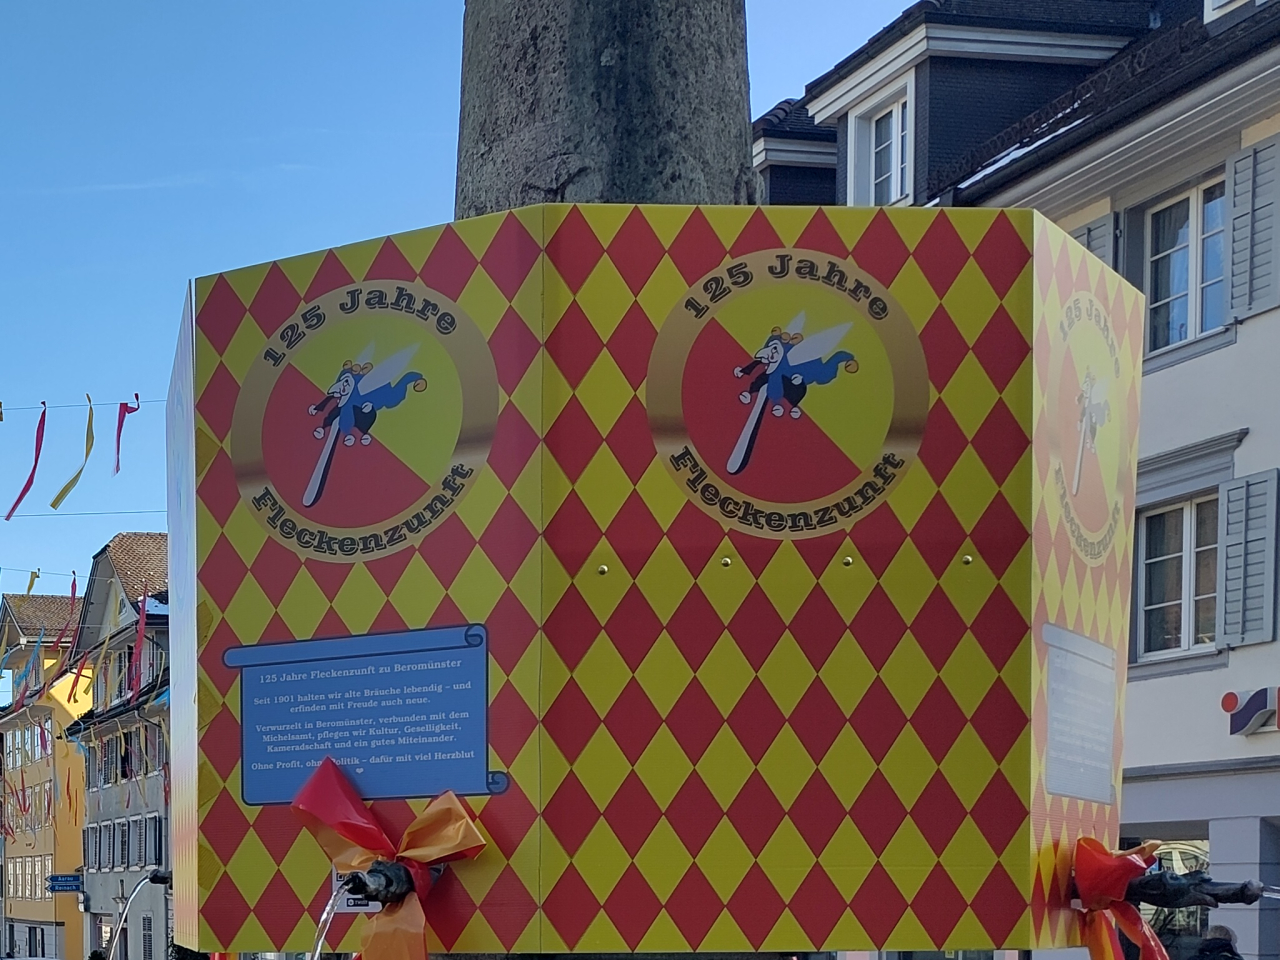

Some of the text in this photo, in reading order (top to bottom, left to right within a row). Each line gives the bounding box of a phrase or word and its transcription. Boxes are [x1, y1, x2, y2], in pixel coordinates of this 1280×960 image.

[684, 254, 889, 320] 125 Jahre
[263, 285, 458, 367] 125 Jahre
[1059, 298, 1082, 342] 125
[669, 446, 905, 532] Fleckenzunft
[252, 463, 474, 556] Fleckenzunft
[260, 660, 462, 683] 125 Jahre Fleckenzunft zu Beromünster
[254, 697, 271, 705] Seit
[274, 695, 294, 704] 1901
[297, 693, 325, 702] halten
[328, 691, 342, 699] wir
[344, 690, 361, 698] alte
[364, 687, 401, 697] Bräuche
[403, 683, 443, 694] lebendig
[453, 681, 471, 690] und
[290, 697, 431, 713] erfinden mit Freude auch neue.
[255, 710, 469, 732] Verwurzelt in Beromünster, verbunden mit dem
[262, 733, 315, 743] Michelsamt,
[317, 731, 350, 741] pflegen
[369, 727, 401, 736] Kultur,
[404, 722, 462, 734] Geselligkeit,
[267, 734, 457, 753] Kameradschaft und ein gutes Miteinander.
[251, 762, 274, 770] Ohne
[276, 760, 304, 769] Profit,
[306, 759, 323, 767] ohn
[369, 756, 393, 764] dafür
[396, 754, 412, 762] mit
[414, 752, 432, 761] viel
[434, 750, 475, 760] Herzblut
